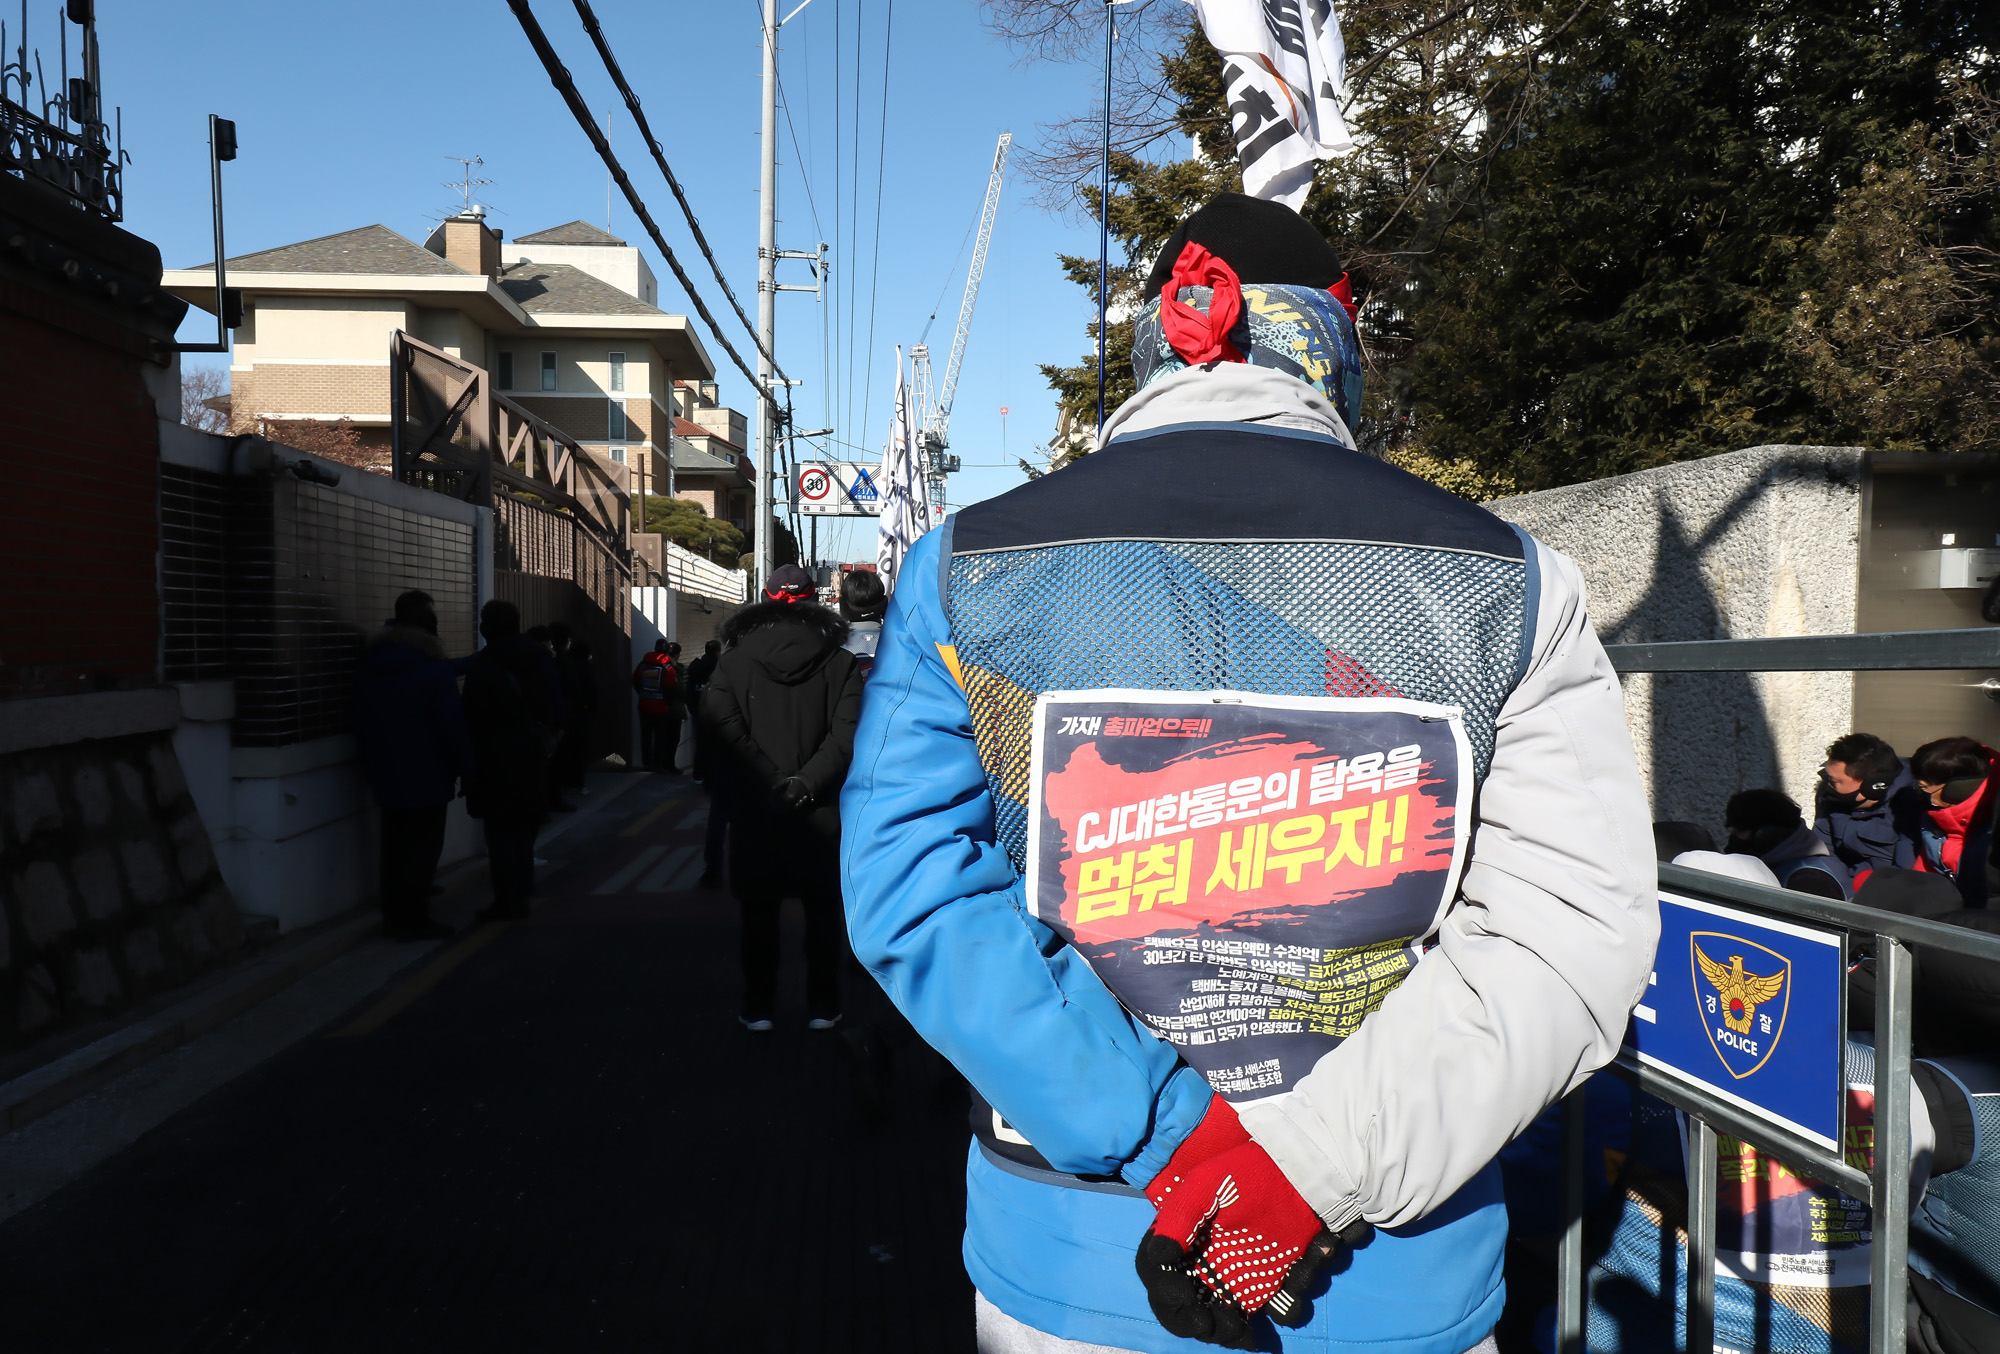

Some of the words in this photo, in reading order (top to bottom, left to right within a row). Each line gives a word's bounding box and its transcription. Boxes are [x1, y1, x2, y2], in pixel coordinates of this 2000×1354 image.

[806, 478, 824, 491] 30
[1057, 716, 1102, 736] 가자!
[1103, 716, 1213, 738] 총파업으로!!
[1075, 767, 1299, 854] CJ대한통운의
[1309, 743, 1423, 804] 탐욕을
[1075, 838, 1194, 925] 멈춰
[1205, 794, 1410, 897] 세우자!
[1144, 936, 1199, 951] 택배요금
[1201, 939, 1272, 958] 인상금액만
[1273, 944, 1320, 962] 수천억!
[1143, 950, 1187, 966] 30년간
[1250, 958, 1306, 977] 인상없는
[1308, 953, 1362, 979] 급지수수료
[1217, 967, 1275, 983] 노예계약
[1343, 969, 1369, 987] 즉각
[1366, 953, 1410, 981] 철회하라!
[1191, 979, 1258, 994] 택배노동자
[1260, 983, 1316, 1002] 등골빼는
[1318, 985, 1368, 1004] 별도요금
[1179, 994, 1225, 1014] 산업재해
[1227, 993, 1282, 1008] 유발하는
[1283, 999, 1340, 1016] 저상탑차
[1341, 998, 1366, 1015] 대책
[1706, 994, 1717, 1014] 경
[1760, 1013, 1773, 1035] 찰
[1145, 1013, 1209, 1031] 차감금액만
[1209, 1008, 1266, 1026] 연간100억!
[1268, 1008, 1337, 1026] 집하수수료
[1338, 1011, 1364, 1026] 차감
[1190, 1029, 1217, 1046] 빼고
[1217, 1023, 1248, 1042] 모두가
[1250, 1021, 1304, 1036] 인정했다.
[1717, 1027, 1758, 1057] POLICE
[1206, 1066, 1243, 1082] 민주노총
[1244, 1058, 1281, 1076] 서비스연맹
[1208, 1071, 1283, 1094] 전국택배노동조합
